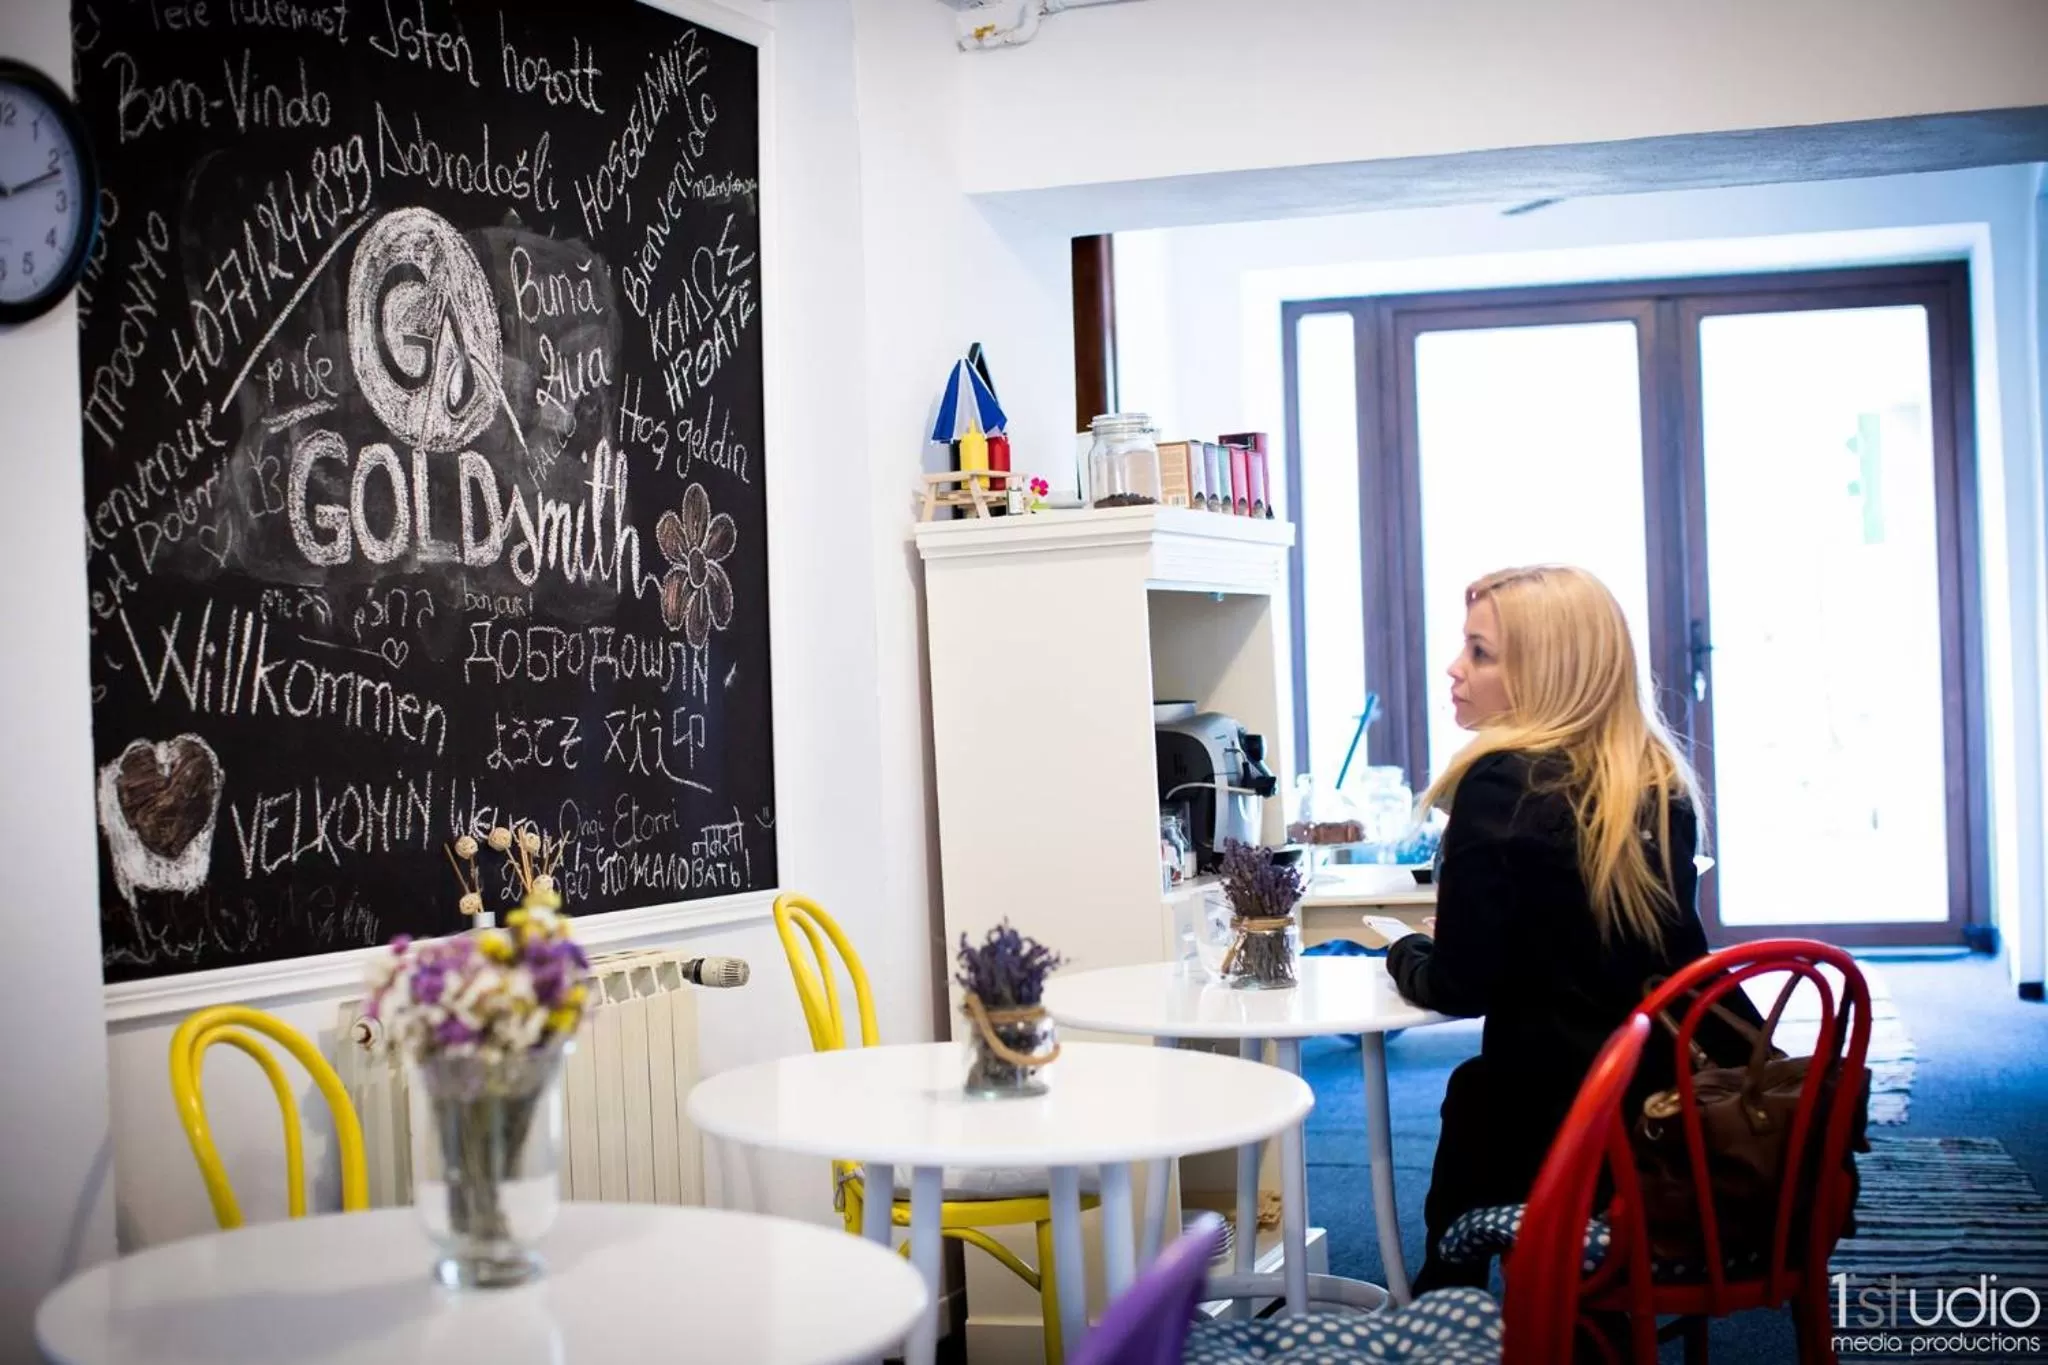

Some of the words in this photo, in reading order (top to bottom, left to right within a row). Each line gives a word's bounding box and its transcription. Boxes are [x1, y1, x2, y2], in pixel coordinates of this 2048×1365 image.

[499, 8, 606, 115] hozott
[102, 47, 331, 144] Bem-Vindo
[55, 189, 68, 214] 3
[22, 250, 36, 276] 5
[44, 226, 57, 250] 4
[119, 597, 447, 755] Willkommen
